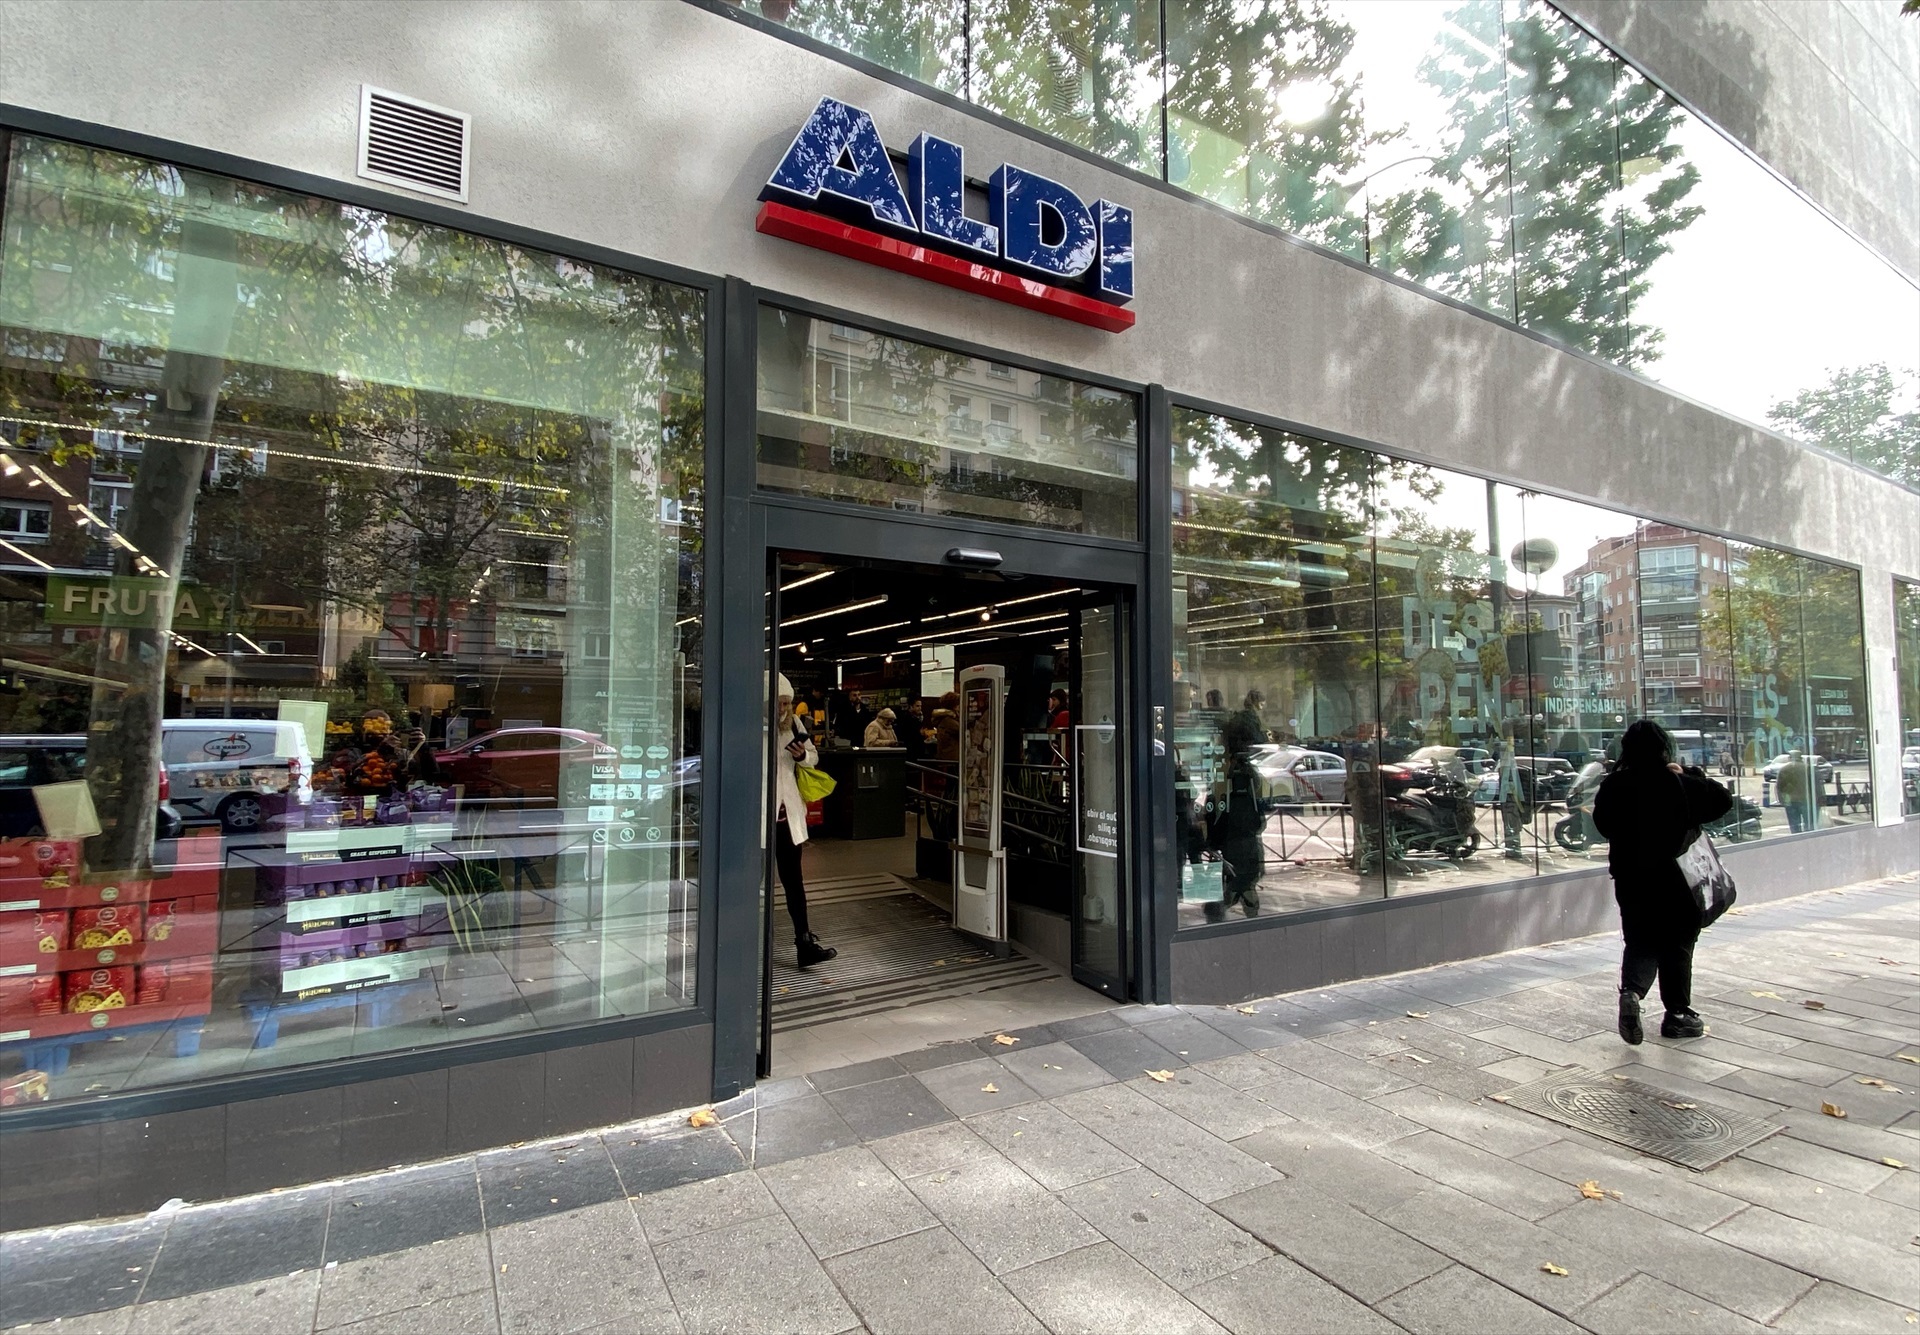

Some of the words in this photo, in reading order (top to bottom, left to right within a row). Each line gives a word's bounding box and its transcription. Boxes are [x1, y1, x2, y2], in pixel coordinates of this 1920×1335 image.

[759, 95, 1135, 305] ALDI
[63, 585, 200, 619] FRUTA
[1545, 697, 1627, 714] INDISPENSABLES
[595, 765, 615, 774] VISA
